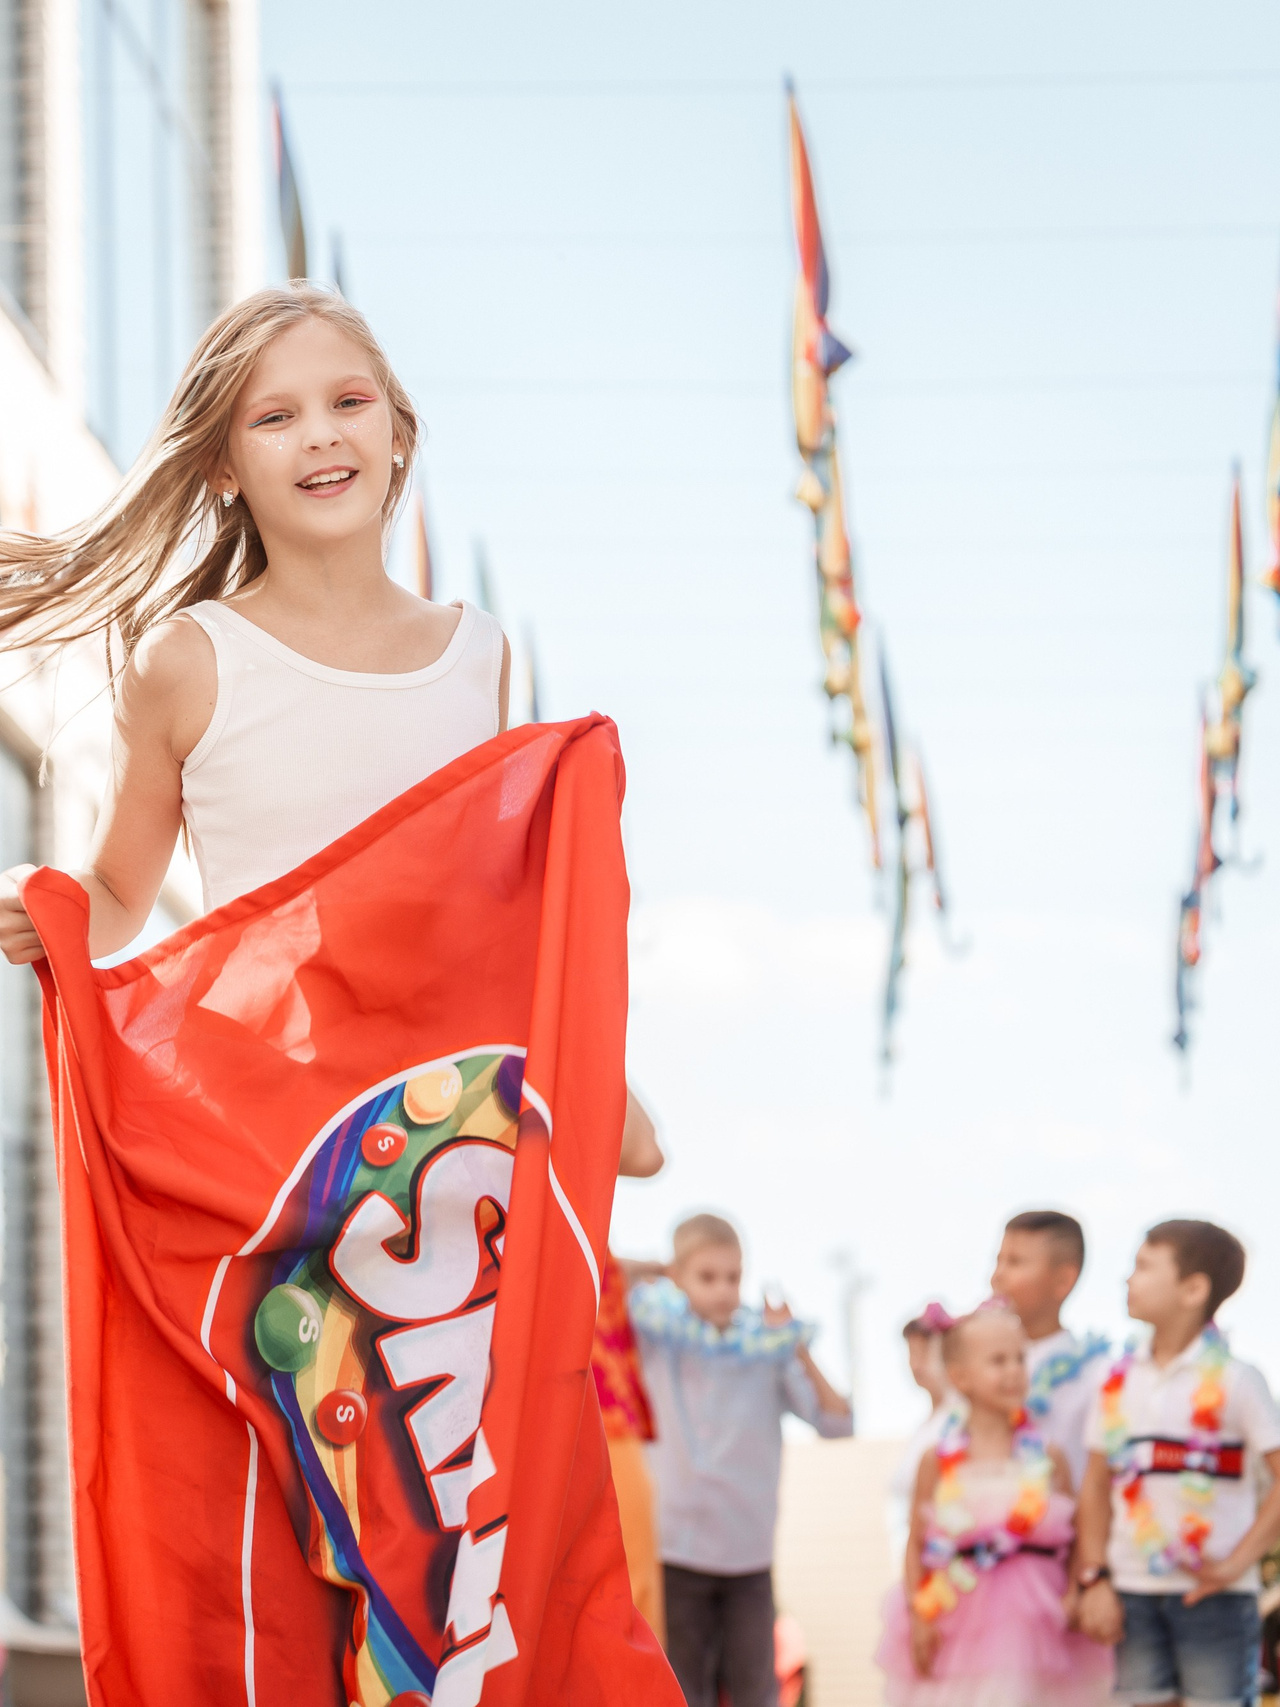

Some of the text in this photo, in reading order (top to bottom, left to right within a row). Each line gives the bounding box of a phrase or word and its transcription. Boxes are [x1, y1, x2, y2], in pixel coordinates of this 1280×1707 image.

[440, 1075, 459, 1098] S
[377, 1135, 395, 1152] S
[298, 1316, 320, 1344] S
[336, 1404, 355, 1423] S
